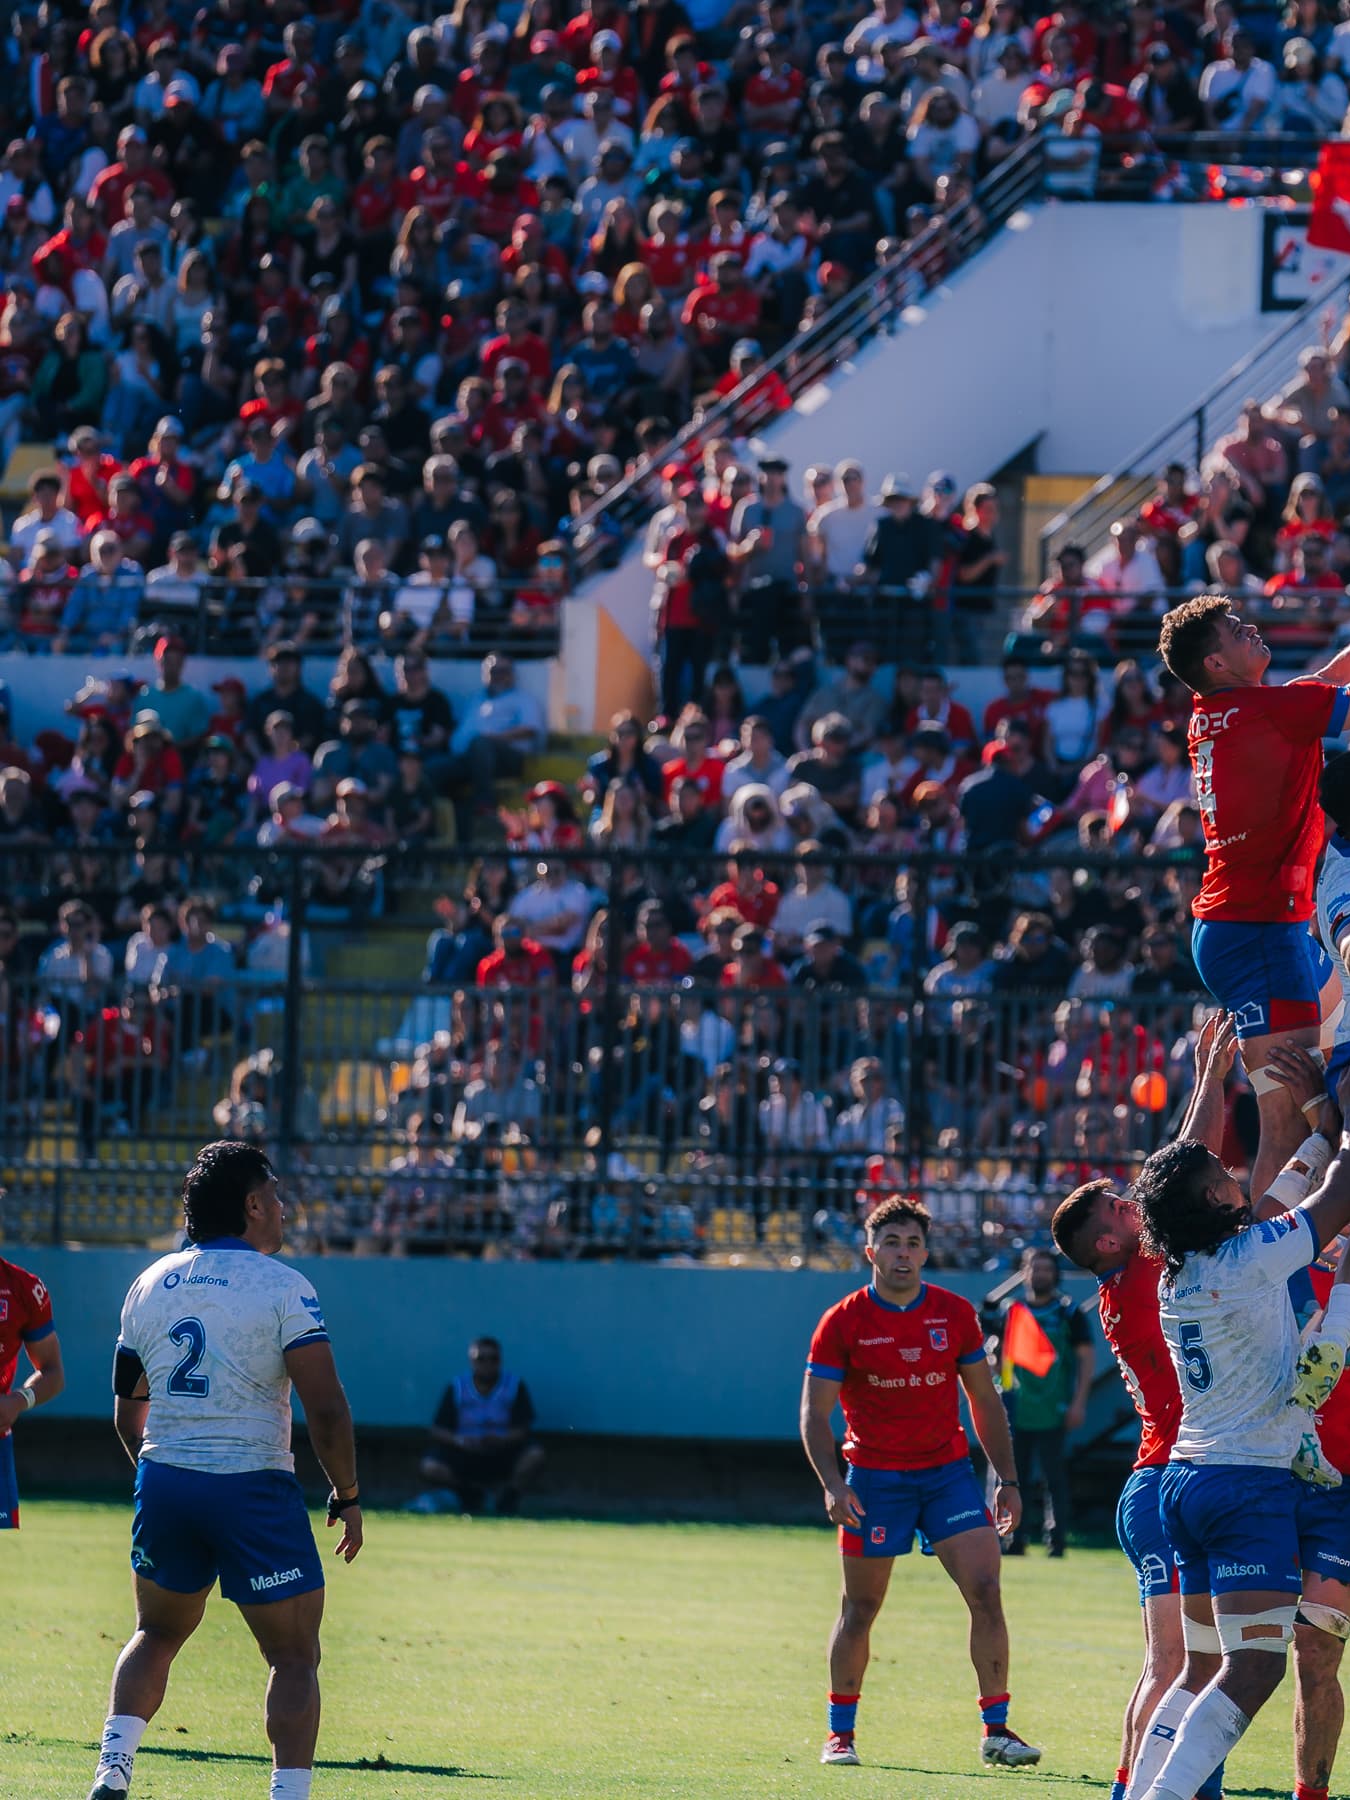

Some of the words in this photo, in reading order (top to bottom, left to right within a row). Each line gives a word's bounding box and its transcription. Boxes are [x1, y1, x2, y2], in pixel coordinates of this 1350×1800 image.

[167, 1316, 209, 1398] 2
[1179, 1321, 1213, 1393] 5
[867, 1374, 906, 1388] Banco
[909, 1373, 922, 1387] de
[1317, 1551, 1350, 1567] marathon
[250, 1567, 304, 1591] Matson
[1216, 1562, 1267, 1580] Matson
